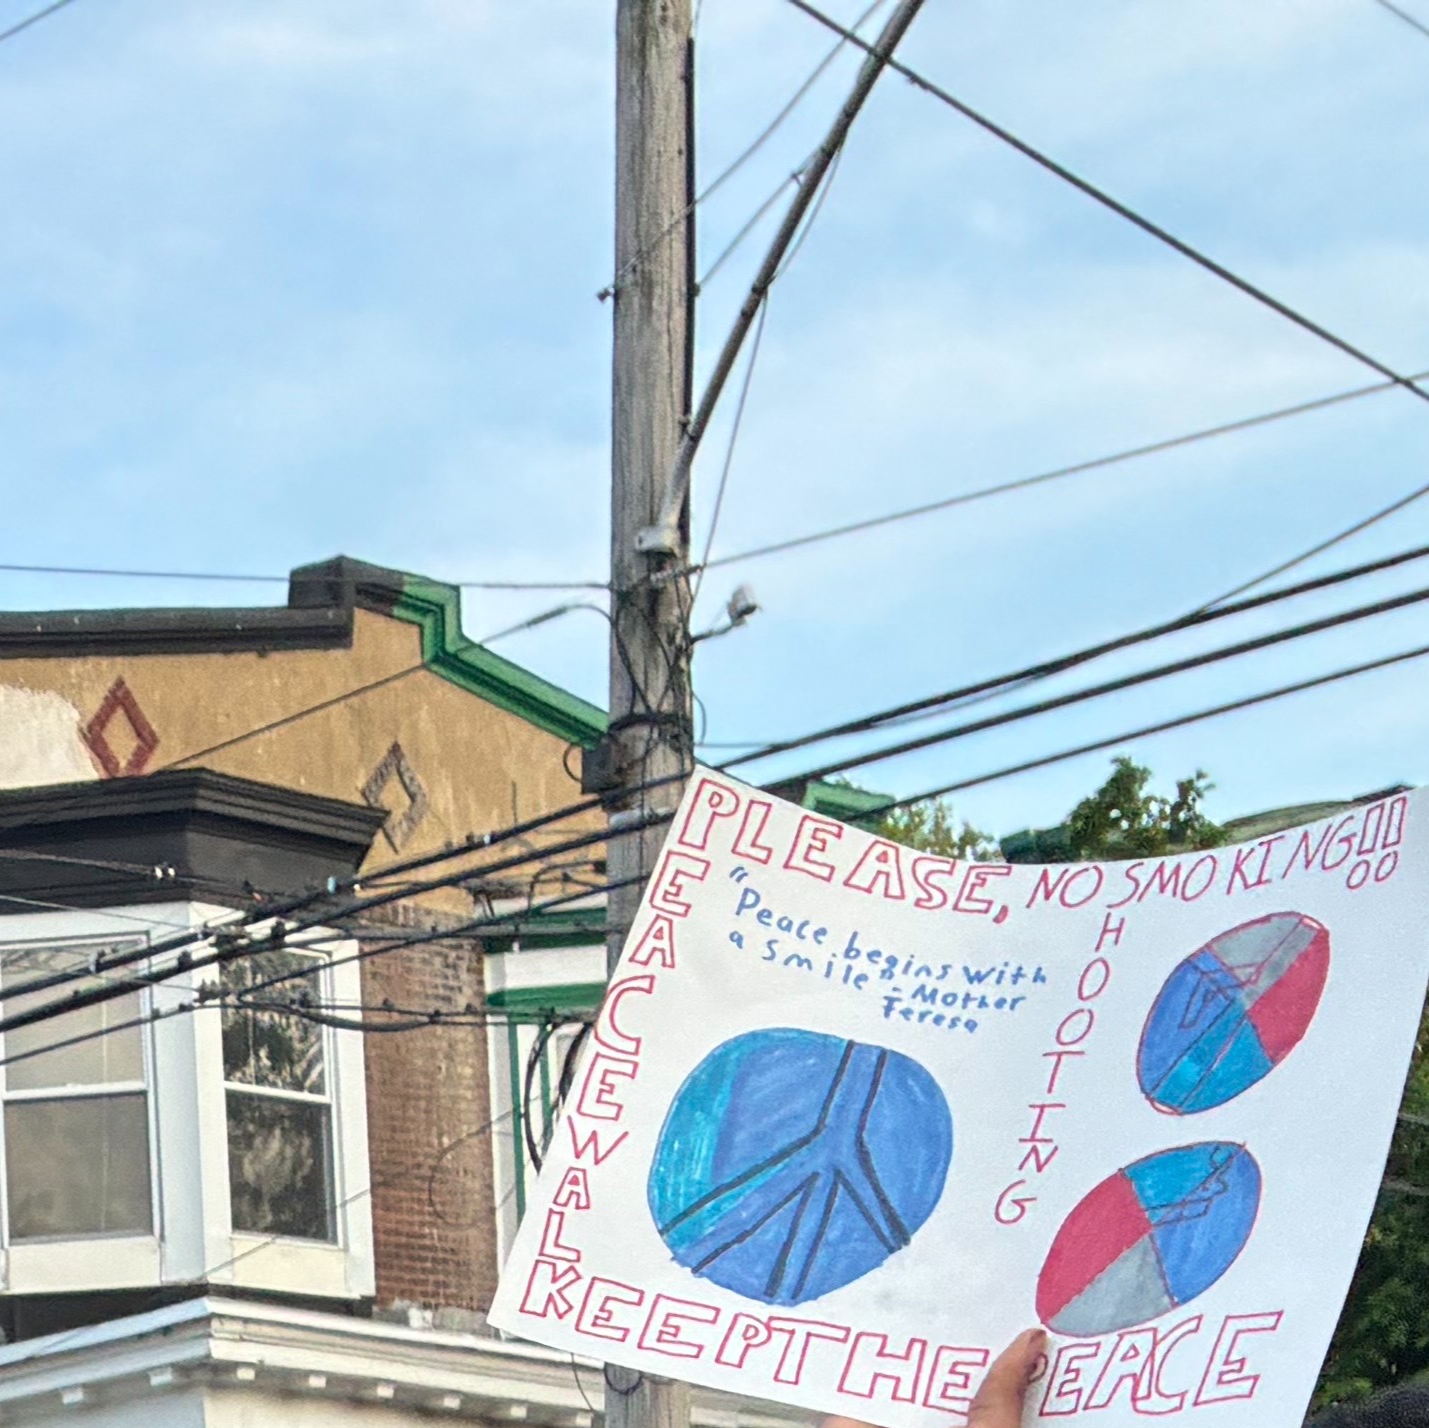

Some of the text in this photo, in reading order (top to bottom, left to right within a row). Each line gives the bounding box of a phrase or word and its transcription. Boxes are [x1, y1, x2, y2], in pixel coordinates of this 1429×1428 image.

[678, 778, 1012, 923] PLEASE,
[1026, 866, 1103, 908] NO
[728, 930, 745, 950] a
[843, 931, 952, 981] begins
[962, 961, 1047, 985] with
[882, 994, 979, 1034] Teresa
[519, 1259, 776, 1369] KEEP
[764, 1317, 990, 1417] THE
